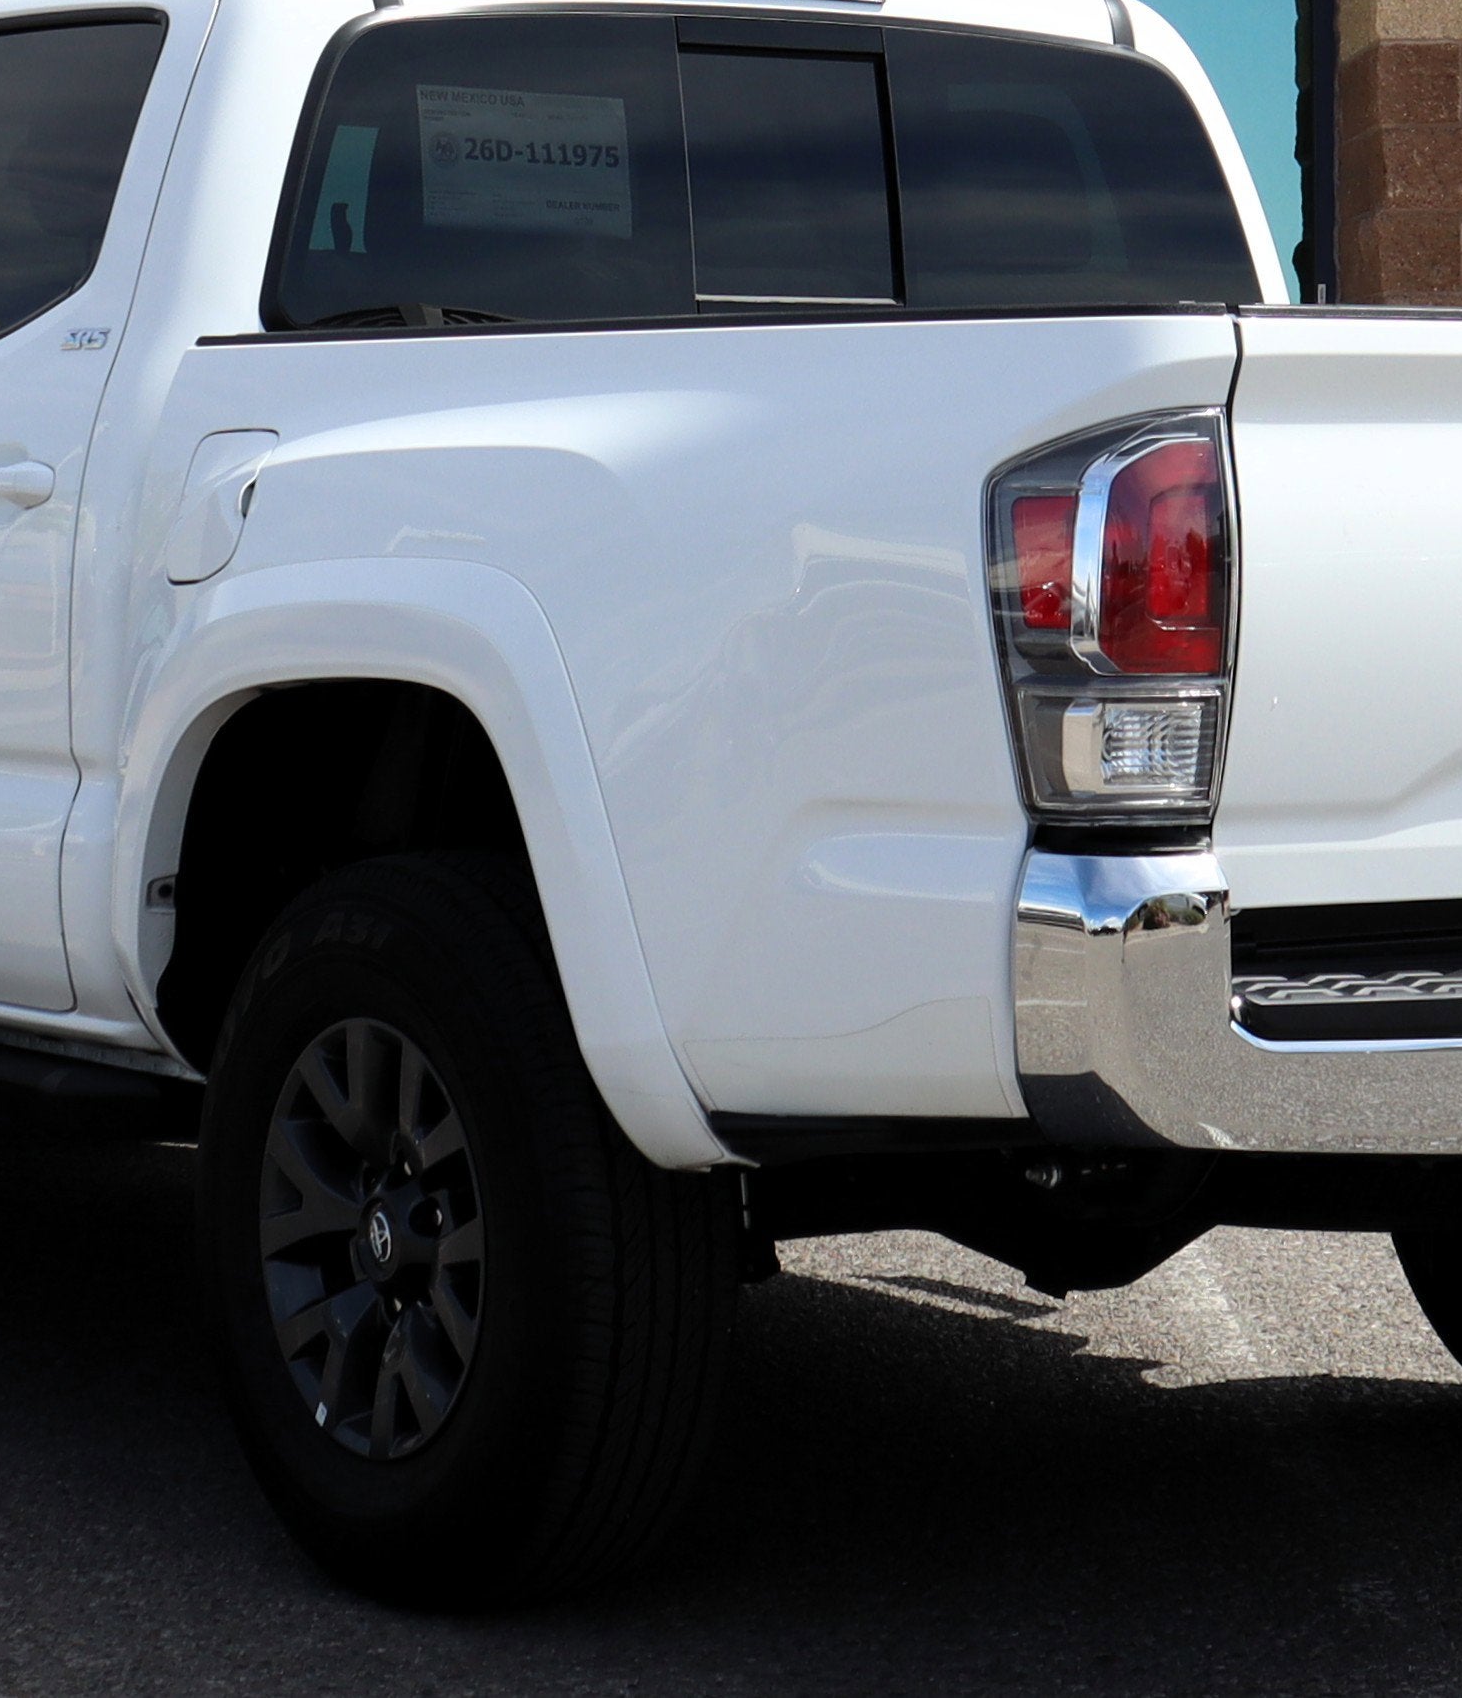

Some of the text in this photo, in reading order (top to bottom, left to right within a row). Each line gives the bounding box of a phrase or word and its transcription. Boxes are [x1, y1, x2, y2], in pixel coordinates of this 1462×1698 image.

[419, 89, 526, 108] NEW MEXICO USA
[464, 137, 621, 168] 26D-111975
